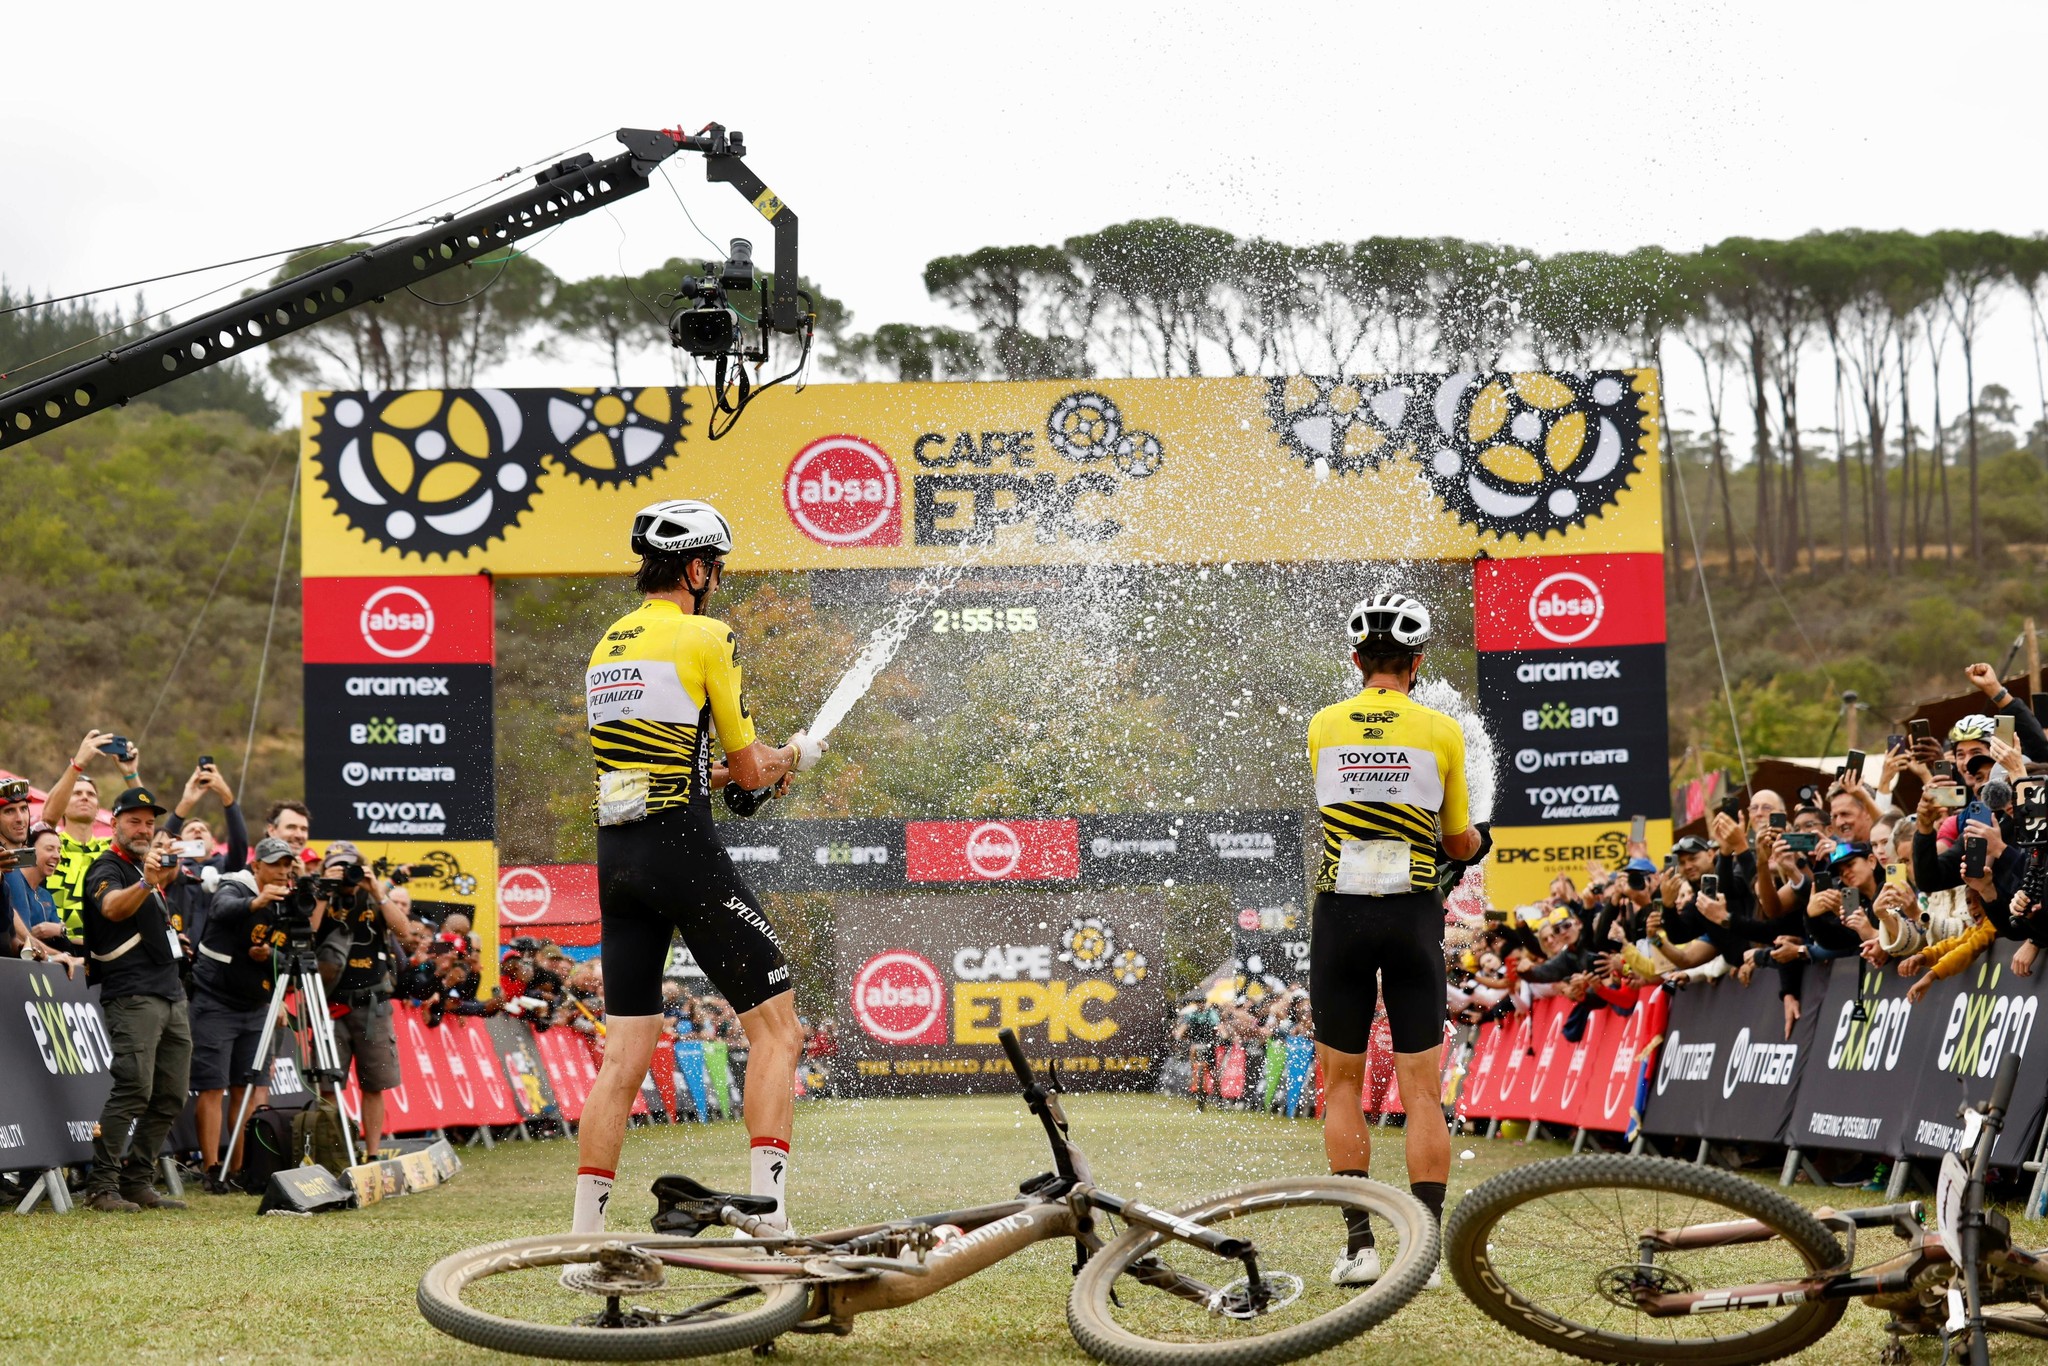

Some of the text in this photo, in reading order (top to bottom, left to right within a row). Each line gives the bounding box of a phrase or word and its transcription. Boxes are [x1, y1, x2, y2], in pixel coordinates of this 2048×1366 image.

[914, 431, 1034, 468] CAPE
[801, 470, 882, 505] absa
[914, 471, 1122, 547] EPIC
[664, 532, 722, 549] SPECIALIZED
[1538, 593, 1595, 617] absa
[369, 607, 425, 630] absa
[932, 608, 1038, 633] 2:55:55
[590, 668, 643, 687] TOYOTA
[1516, 660, 1621, 683] aramex
[345, 676, 450, 696] aramex
[1522, 702, 1620, 731] exxaro
[349, 716, 446, 745] exxaro
[698, 730, 709, 787] CAPE EPIC
[1339, 752, 1408, 765] TOYOTA
[1543, 749, 1629, 767] NTT DATA
[370, 766, 455, 782] NTT DATA
[1340, 772, 1410, 783] SPECIALIZED
[1525, 784, 1619, 806] TOYOTA
[353, 802, 445, 820] TOYOTA
[1541, 803, 1620, 819] LAND CRUISER
[368, 819, 446, 836] LAND CRUISER
[1497, 844, 1620, 863] EPIC SERIES
[1364, 873, 1399, 884] Howard
[953, 945, 1051, 979] CAPE
[865, 979, 931, 1007] absa
[955, 979, 1119, 1044] EPIC
[1671, 1042, 1693, 1081] NTT
[1740, 1043, 1768, 1083] NTT
[1809, 1112, 1883, 1140] POWERING POSSIBILITY
[1915, 1119, 1953, 1151] POWERING
